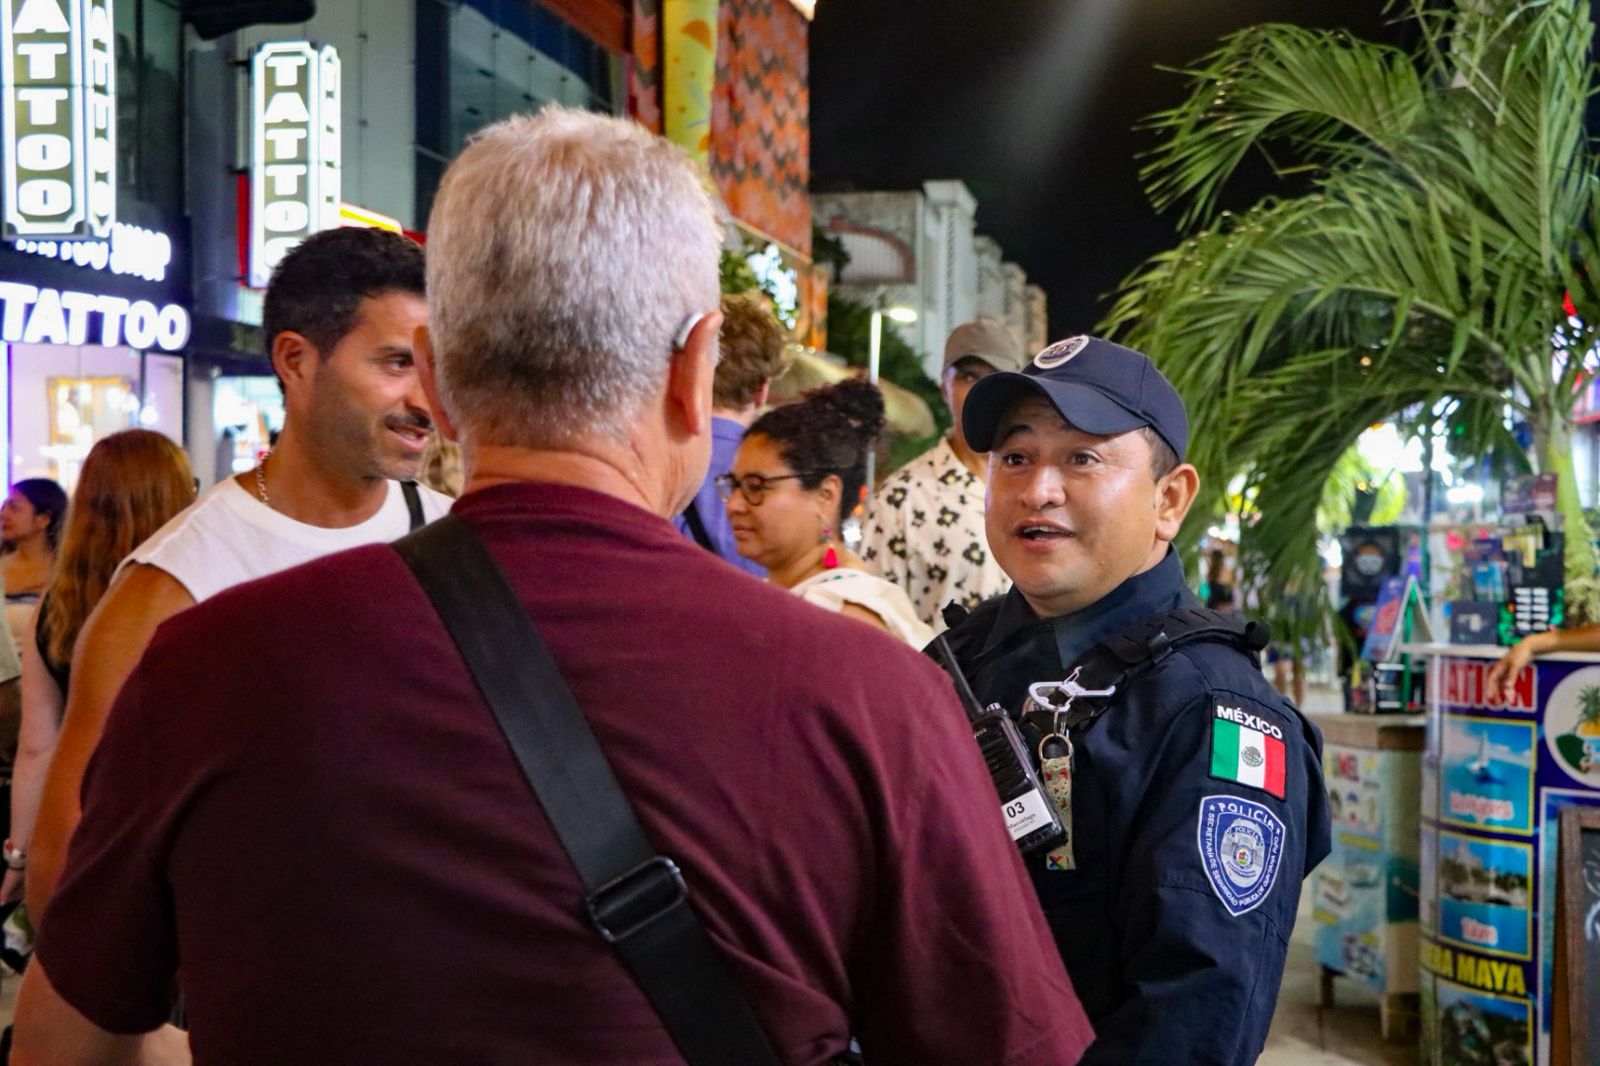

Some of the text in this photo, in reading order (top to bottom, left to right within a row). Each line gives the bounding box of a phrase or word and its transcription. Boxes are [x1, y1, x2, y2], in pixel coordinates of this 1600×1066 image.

[0, 281, 190, 350] TATTOO
[1217, 705, 1282, 739] MÉXICO
[1006, 801, 1025, 818] 03
[1456, 953, 1527, 996] MAYA
